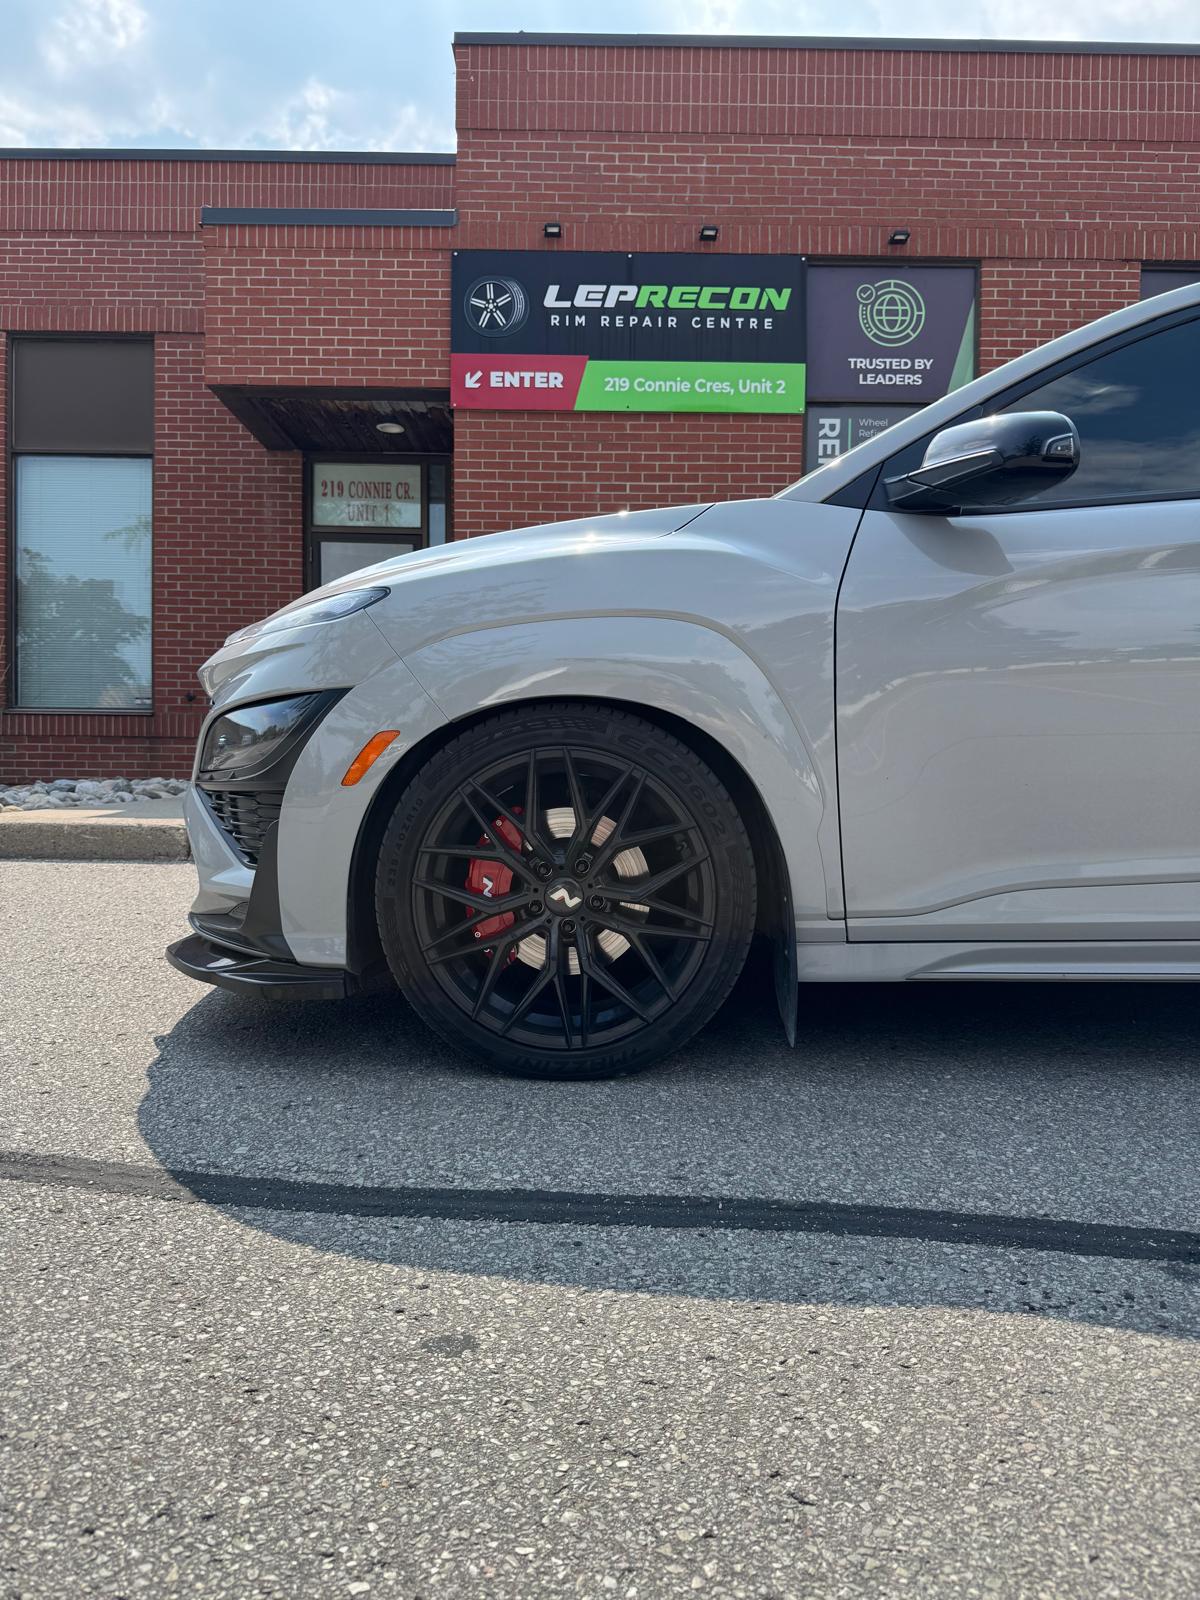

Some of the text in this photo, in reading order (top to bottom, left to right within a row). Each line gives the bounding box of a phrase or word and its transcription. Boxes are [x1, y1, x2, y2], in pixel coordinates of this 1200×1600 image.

[543, 285, 792, 311] LEPRECON
[551, 315, 773, 330] RIM REPAIR CENTRE
[848, 358, 933, 370] TRUSTED BY
[490, 372, 563, 388] ENTER
[604, 378, 786, 395] 219 Connie Cres, Unit 2
[859, 374, 922, 385] LEADERS
[859, 418, 888, 427] Wheel
[321, 480, 415, 500] 219 CONNIE CR.
[347, 504, 390, 521] UNIT 1
